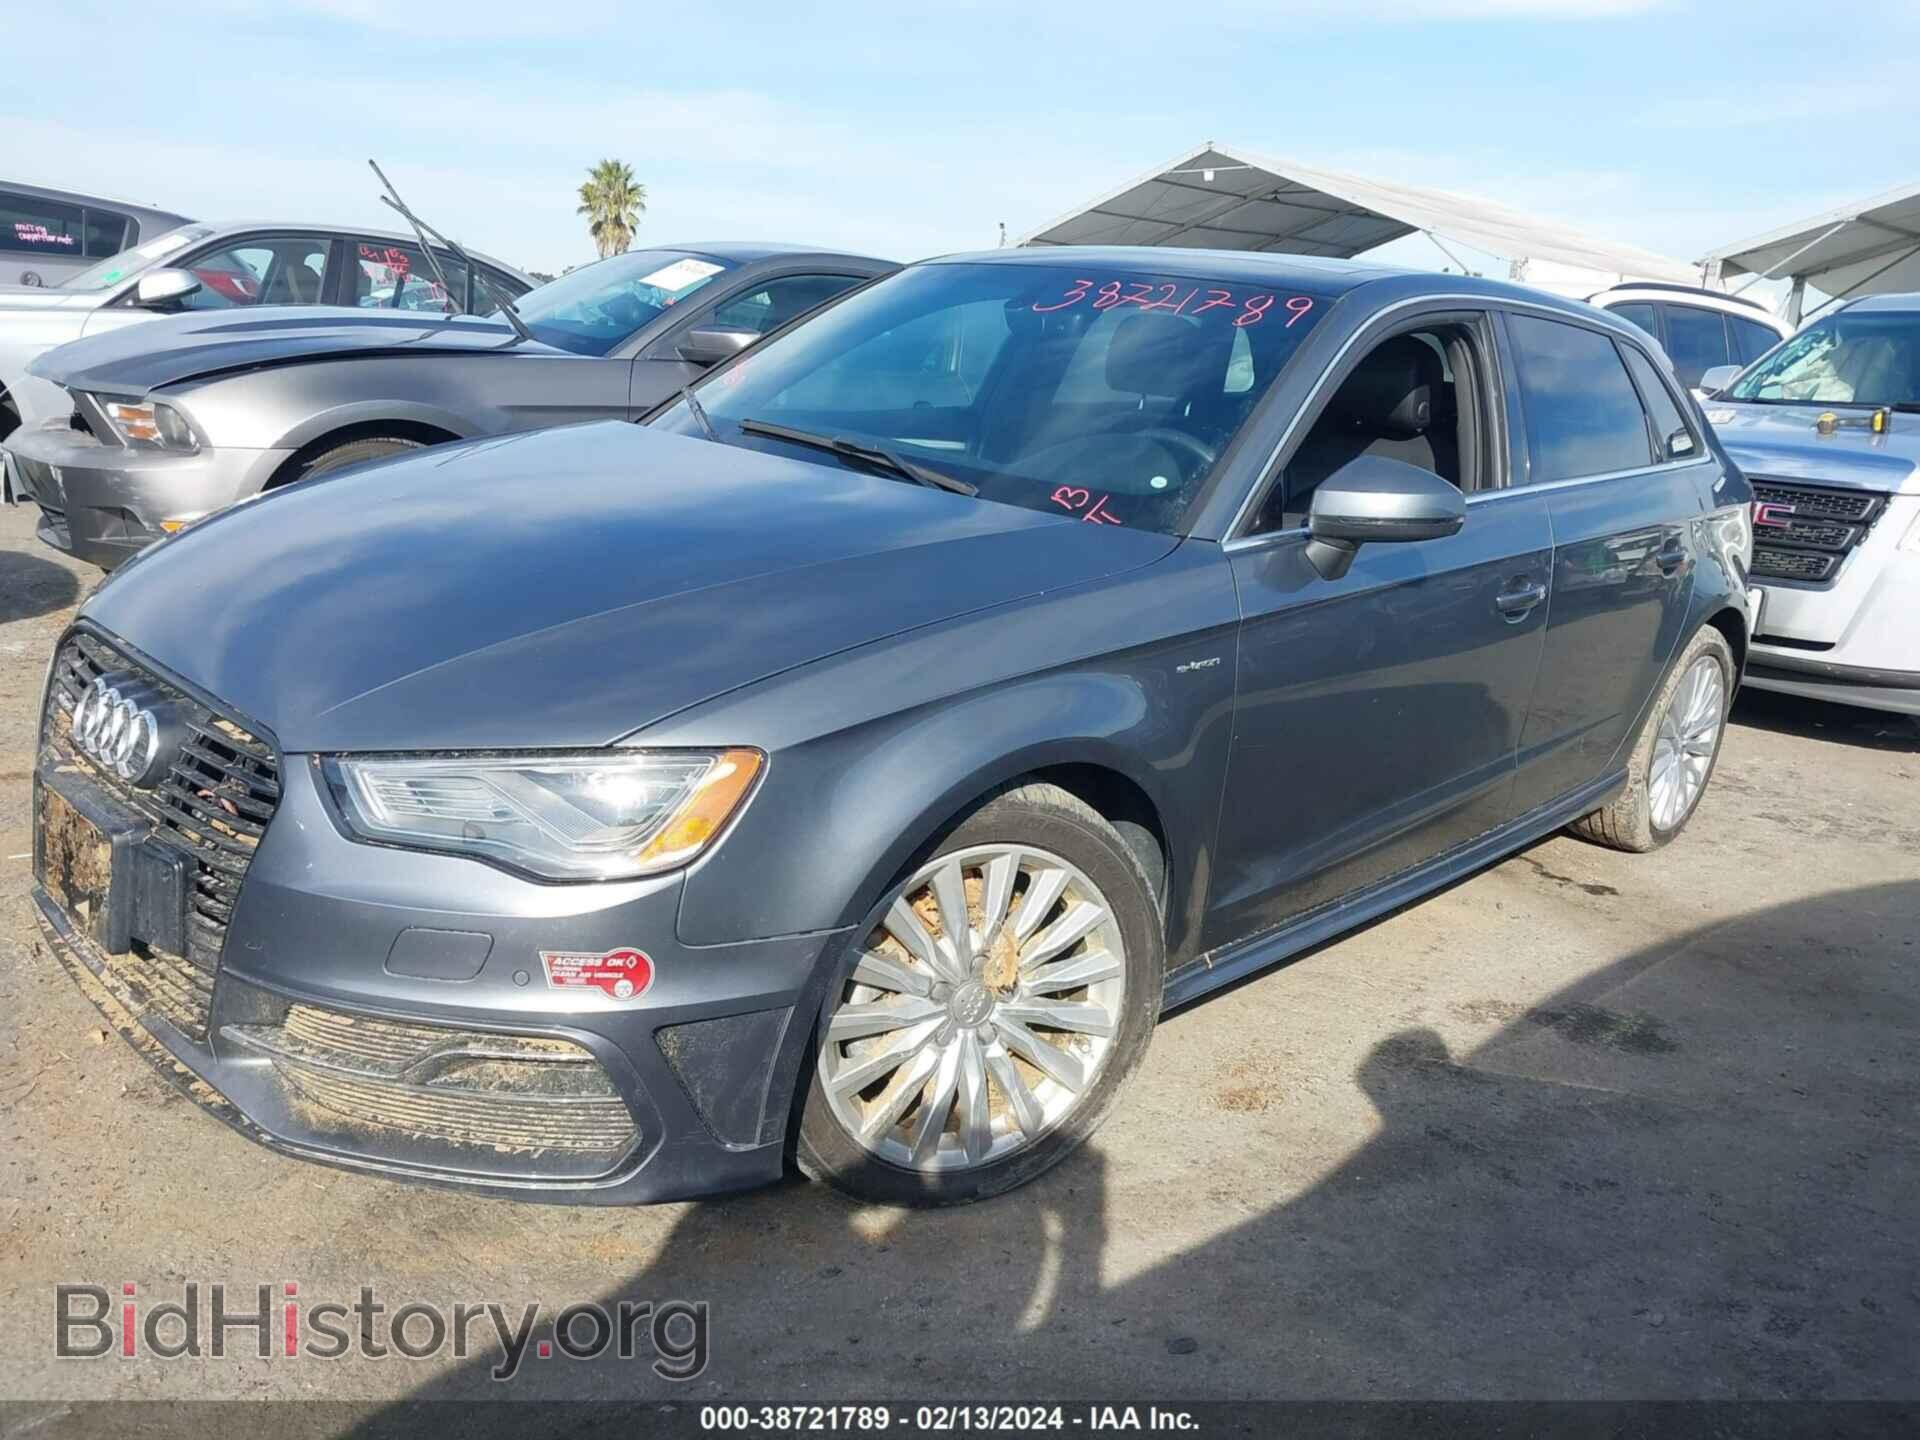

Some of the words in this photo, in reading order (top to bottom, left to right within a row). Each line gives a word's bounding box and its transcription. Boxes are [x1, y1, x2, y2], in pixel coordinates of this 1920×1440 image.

[1032, 280, 1313, 328] 38721789
[552, 957, 602, 967] ACCESS
[606, 957, 625, 967] OK
